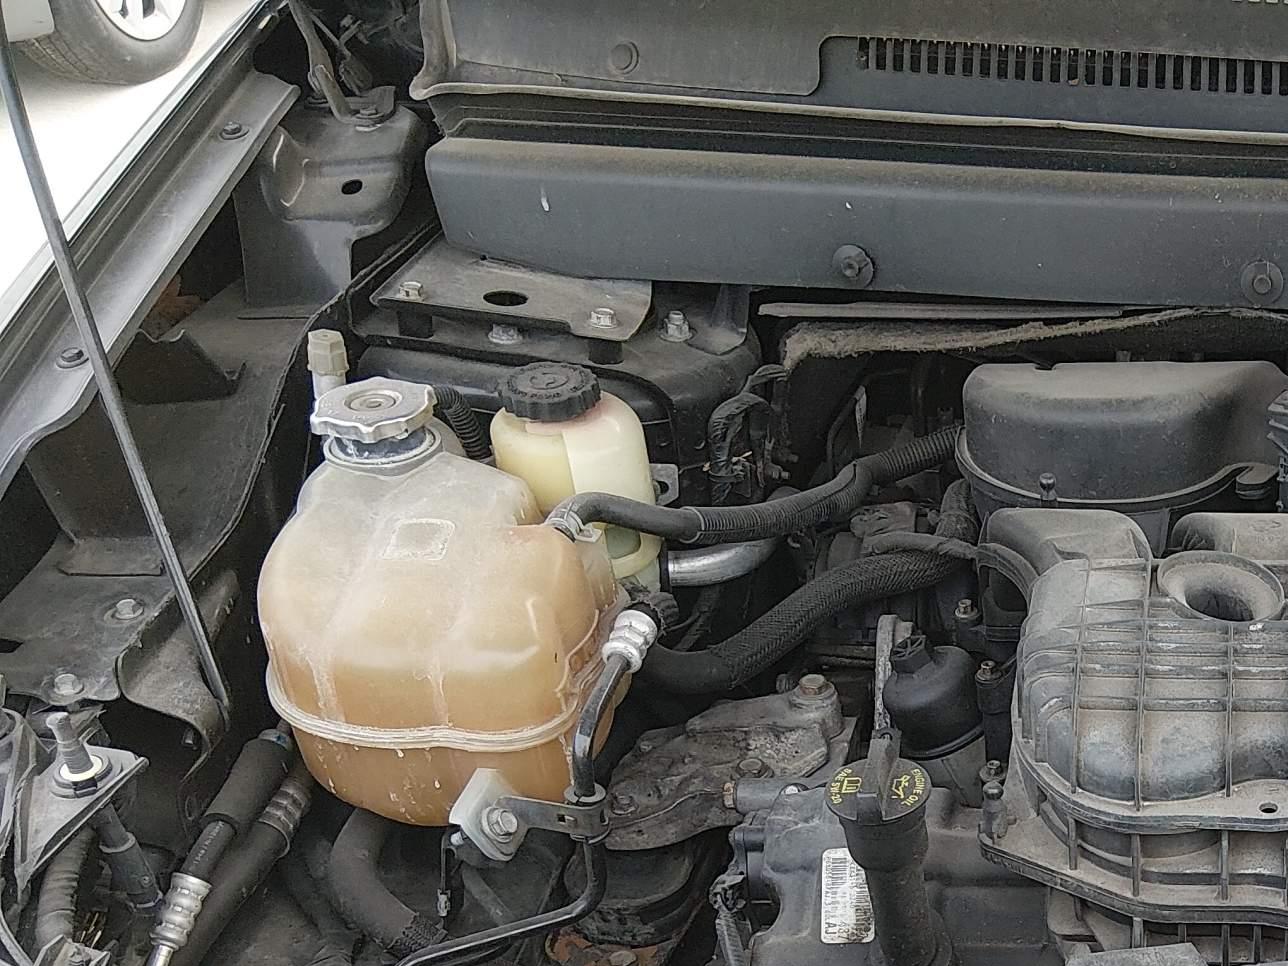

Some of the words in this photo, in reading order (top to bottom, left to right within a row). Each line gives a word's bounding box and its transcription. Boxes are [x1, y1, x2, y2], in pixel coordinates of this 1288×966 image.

[834, 768, 853, 782] SAE
[911, 768, 926, 795] ENGINE
[830, 782, 843, 804] 5W-20
[901, 795, 919, 806] OIL
